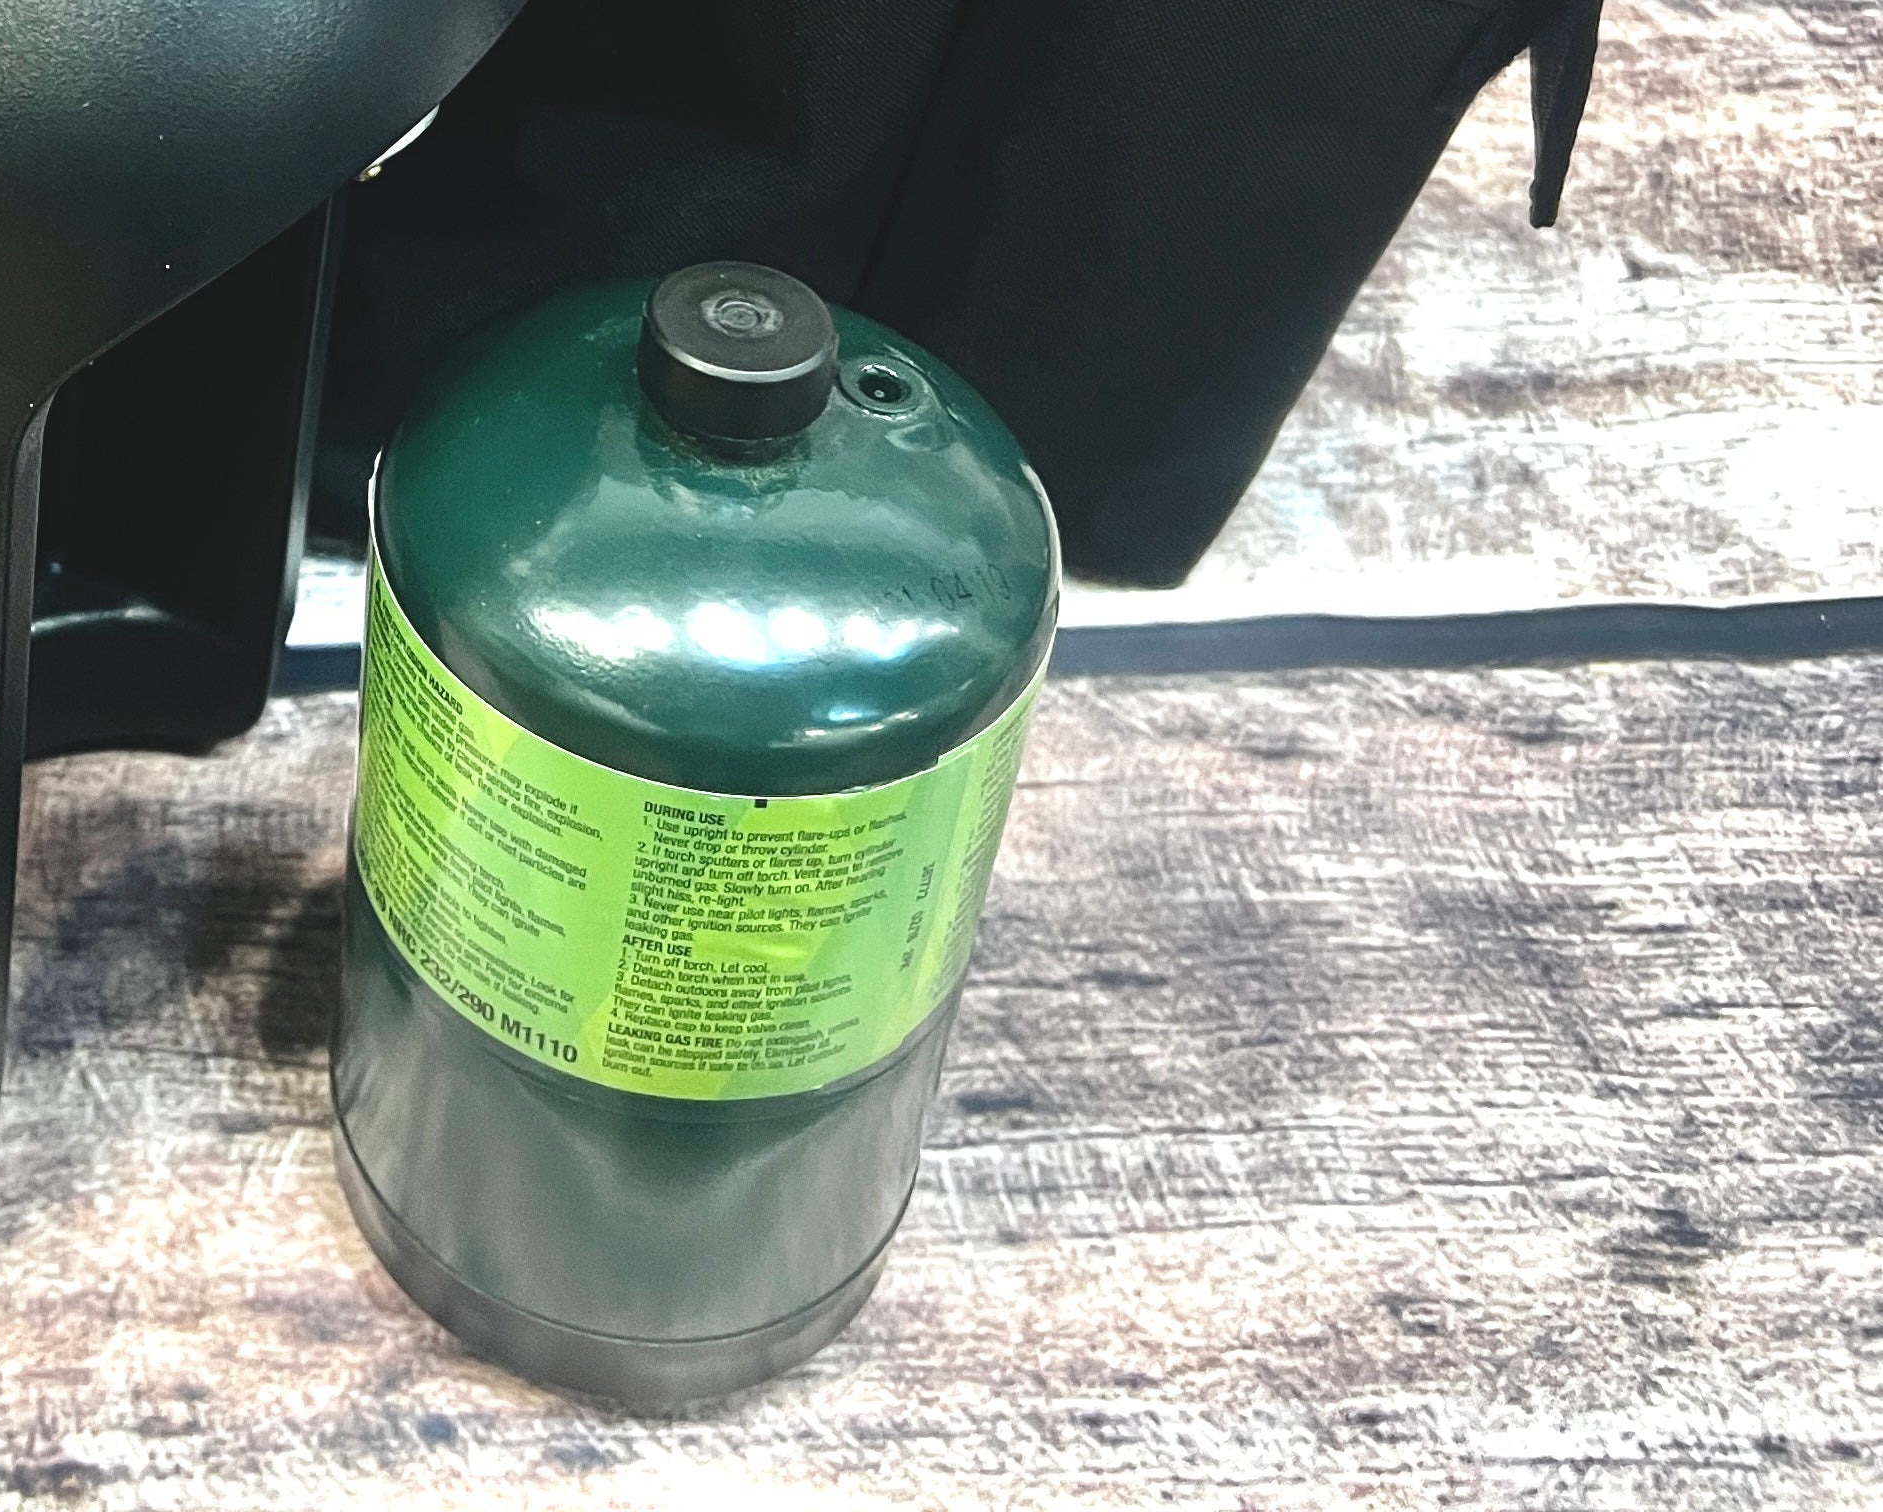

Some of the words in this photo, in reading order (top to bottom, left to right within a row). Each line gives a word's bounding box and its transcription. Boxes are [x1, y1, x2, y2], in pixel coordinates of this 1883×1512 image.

[429, 674, 462, 715] HAZARD
[500, 768, 521, 788] may
[525, 783, 566, 811] explode
[570, 803, 578, 814] if
[498, 795, 508, 807] or
[511, 803, 563, 837] explosion.
[547, 809, 602, 840] explosion,
[644, 801, 694, 821] DURING
[699, 812, 725, 826] USE
[654, 831, 689, 848] Never
[694, 840, 721, 854] drop
[725, 845, 737, 853] or
[742, 843, 777, 855] throw
[780, 844, 828, 856] cylinder.
[657, 818, 679, 833] Use
[684, 825, 728, 841] upright
[732, 831, 743, 841] to
[747, 832, 794, 843] prevent
[798, 828, 851, 840] flare-ups
[854, 825, 866, 835] or
[510, 832, 532, 852] with
[535, 848, 586, 877] damaged
[637, 842, 649, 853] 2.
[653, 845, 661, 855] If
[665, 848, 695, 862] torch
[699, 855, 749, 868] sputters
[753, 859, 765, 868] or
[770, 857, 802, 867] flares
[807, 857, 824, 868] up,
[829, 854, 851, 864] turn
[519, 852, 564, 882] particles
[568, 877, 586, 890] are
[635, 856, 678, 874] upright
[682, 865, 705, 877] and
[709, 868, 733, 880] turn
[737, 870, 753, 880] off
[757, 870, 790, 881] torch.
[795, 868, 821, 879] Vent
[823, 866, 849, 877] area
[852, 862, 862, 872] to
[631, 881, 663, 898] slight
[668, 888, 694, 904] hiss,
[633, 869, 691, 888] unburned
[695, 881, 718, 893] gas.
[724, 882, 764, 896] Slowly
[768, 885, 791, 895] turn
[795, 883, 812, 893] on.
[816, 880, 844, 891] After
[627, 907, 649, 920] and
[653, 912, 684, 927] other
[688, 918, 732, 932] ignition
[735, 921, 784, 932] sources.
[789, 919, 817, 931] They
[820, 917, 840, 928] can
[644, 896, 679, 912] Never
[683, 906, 704, 916] use
[708, 908, 735, 919] near
[739, 909, 765, 921] pilot
[768, 908, 802, 920] lights,
[625, 919, 668, 939] leaking
[622, 934, 663, 952] AFTER
[667, 944, 692, 957] USE
[618, 959, 628, 971] 2.
[633, 963, 675, 980] Detach
[679, 972, 709, 984] torch
[713, 974, 744, 985] when
[748, 975, 767, 985] not
[770, 974, 781, 983] in
[635, 950, 660, 964] Turn
[664, 958, 681, 968] off
[684, 959, 717, 972] torch.
[721, 963, 740, 973] Let
[743, 963, 770, 973] cool.
[615, 983, 656, 1003] flames,
[706, 999, 729, 1008] and
[732, 1000, 763, 1009] other
[766, 997, 807, 1010] ignition
[616, 971, 627, 984] 3.
[631, 975, 673, 992] Detach
[676, 984, 727, 998] outdoors
[730, 988, 762, 999] away
[766, 986, 792, 996] from
[420, 949, 495, 1021] 232/290
[501, 1012, 578, 1063] M1110
[612, 994, 642, 1012] They
[644, 1004, 665, 1015] can
[669, 1005, 701, 1020] ignite
[705, 1011, 747, 1023] leaking
[750, 1011, 774, 1022] gas.
[608, 1022, 662, 1042] LEAKING
[666, 1034, 691, 1046] GAS
[695, 1038, 723, 1048] FIRE
[726, 1039, 741, 1048] Do
[625, 1011, 671, 1029] Replace
[675, 1021, 696, 1032] cap
[700, 1022, 711, 1033] to
[715, 1022, 743, 1034] keep
[747, 1023, 776, 1033] valve
[604, 1046, 646, 1063] ignition
[650, 1056, 695, 1070] sources
[698, 1058, 706, 1071] if
[606, 1034, 630, 1049] leak
[633, 1041, 654, 1053] can
[658, 1045, 672, 1056] be
[675, 1048, 722, 1060] stopped
[602, 1057, 628, 1073] burn
